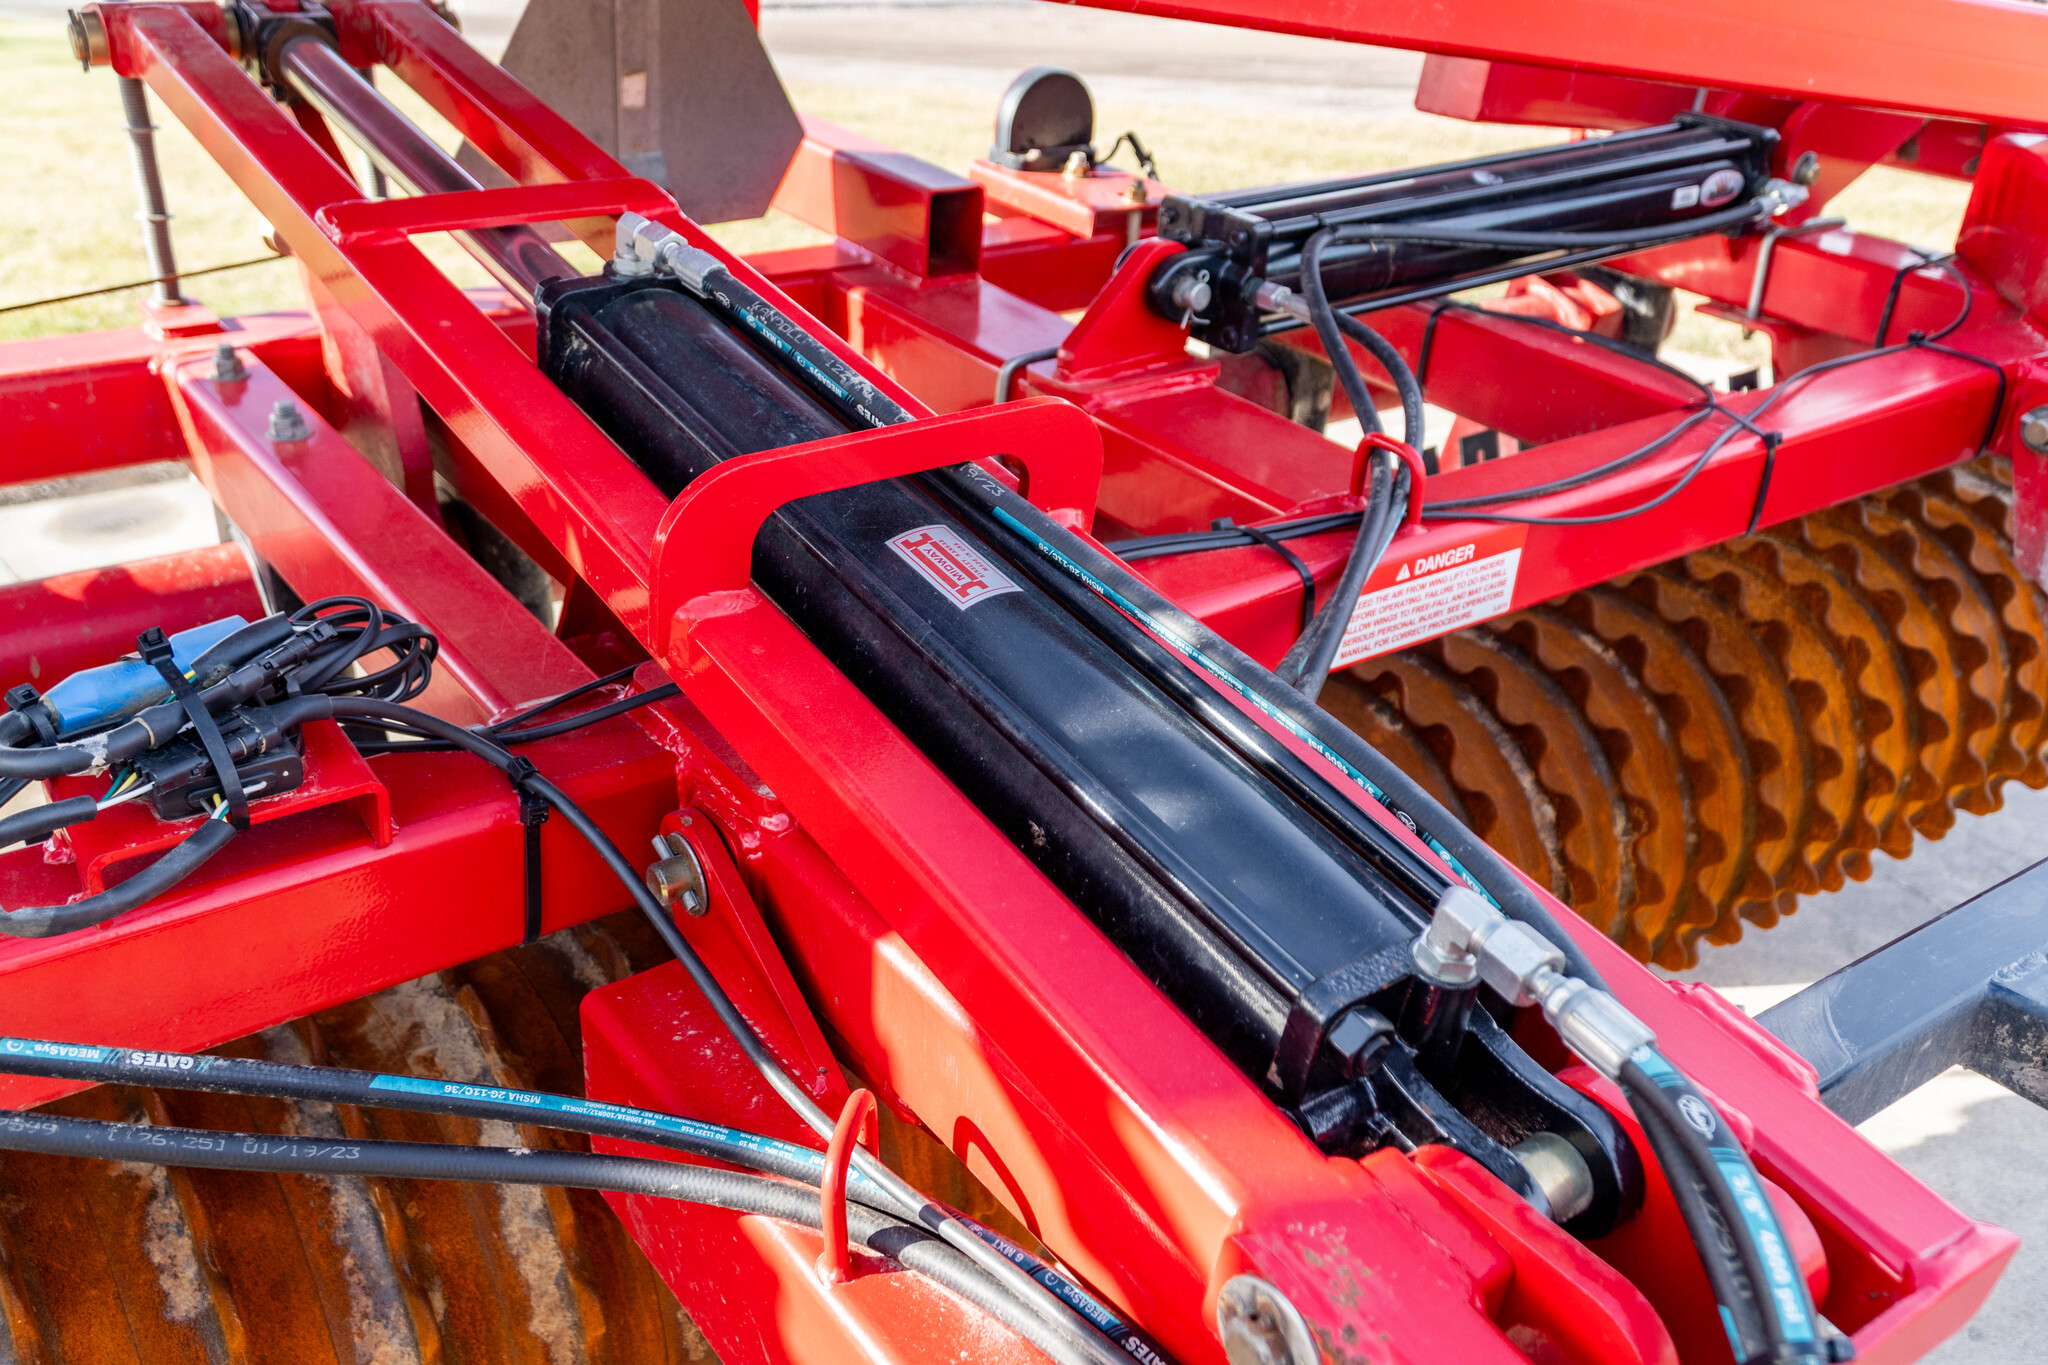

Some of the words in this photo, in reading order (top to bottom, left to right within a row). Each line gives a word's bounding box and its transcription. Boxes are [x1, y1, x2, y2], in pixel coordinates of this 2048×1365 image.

[857, 404, 885, 428] ATES
[960, 466, 1005, 496] 19/23
[939, 540, 960, 557] KANSAS
[954, 543, 966, 551] USA
[923, 549, 965, 581] MIDWAY
[961, 560, 985, 578] KINSLEY,
[972, 559, 988, 571] MADE
[1414, 544, 1475, 575] DANGER
[1081, 573, 1104, 594] MSHA
[1376, 594, 1389, 603] THE
[1392, 590, 1403, 598] AIR
[1406, 583, 1427, 594] FROM
[1428, 576, 1446, 588] WING
[1449, 571, 1463, 581] LIFT
[1466, 559, 1504, 576] CYLINDERS
[1425, 585, 1454, 599] FAILURE
[1457, 581, 1466, 589] TO
[1467, 578, 1478, 586] DO
[1480, 574, 1489, 582] SO
[1343, 622, 1371, 636] ALLOW
[1374, 614, 1397, 626] WINGS
[1401, 609, 1410, 618] TO
[1412, 600, 1448, 614] FREE-FALL
[1452, 593, 1464, 601] AND
[1468, 588, 1481, 596] MAY
[1484, 579, 1506, 591] CAUSE
[1342, 632, 1375, 647] SERIOUS
[1377, 620, 1415, 635] PERSONAL
[1447, 605, 1460, 614] SEE
[1340, 645, 1371, 659] MANUAL
[1374, 638, 1389, 647] FOR
[1391, 625, 1426, 642] CORRECT
[131, 1052, 194, 1069] GATES
[444, 1085, 506, 1099] 2G-11C/36
[509, 1092, 541, 1104] MSHA
[643, 1118, 656, 1126] SAE
[694, 1129, 715, 1138] 11237
[991, 1238, 1016, 1257] MXT
[1125, 1336, 1166, 1365] ATES
